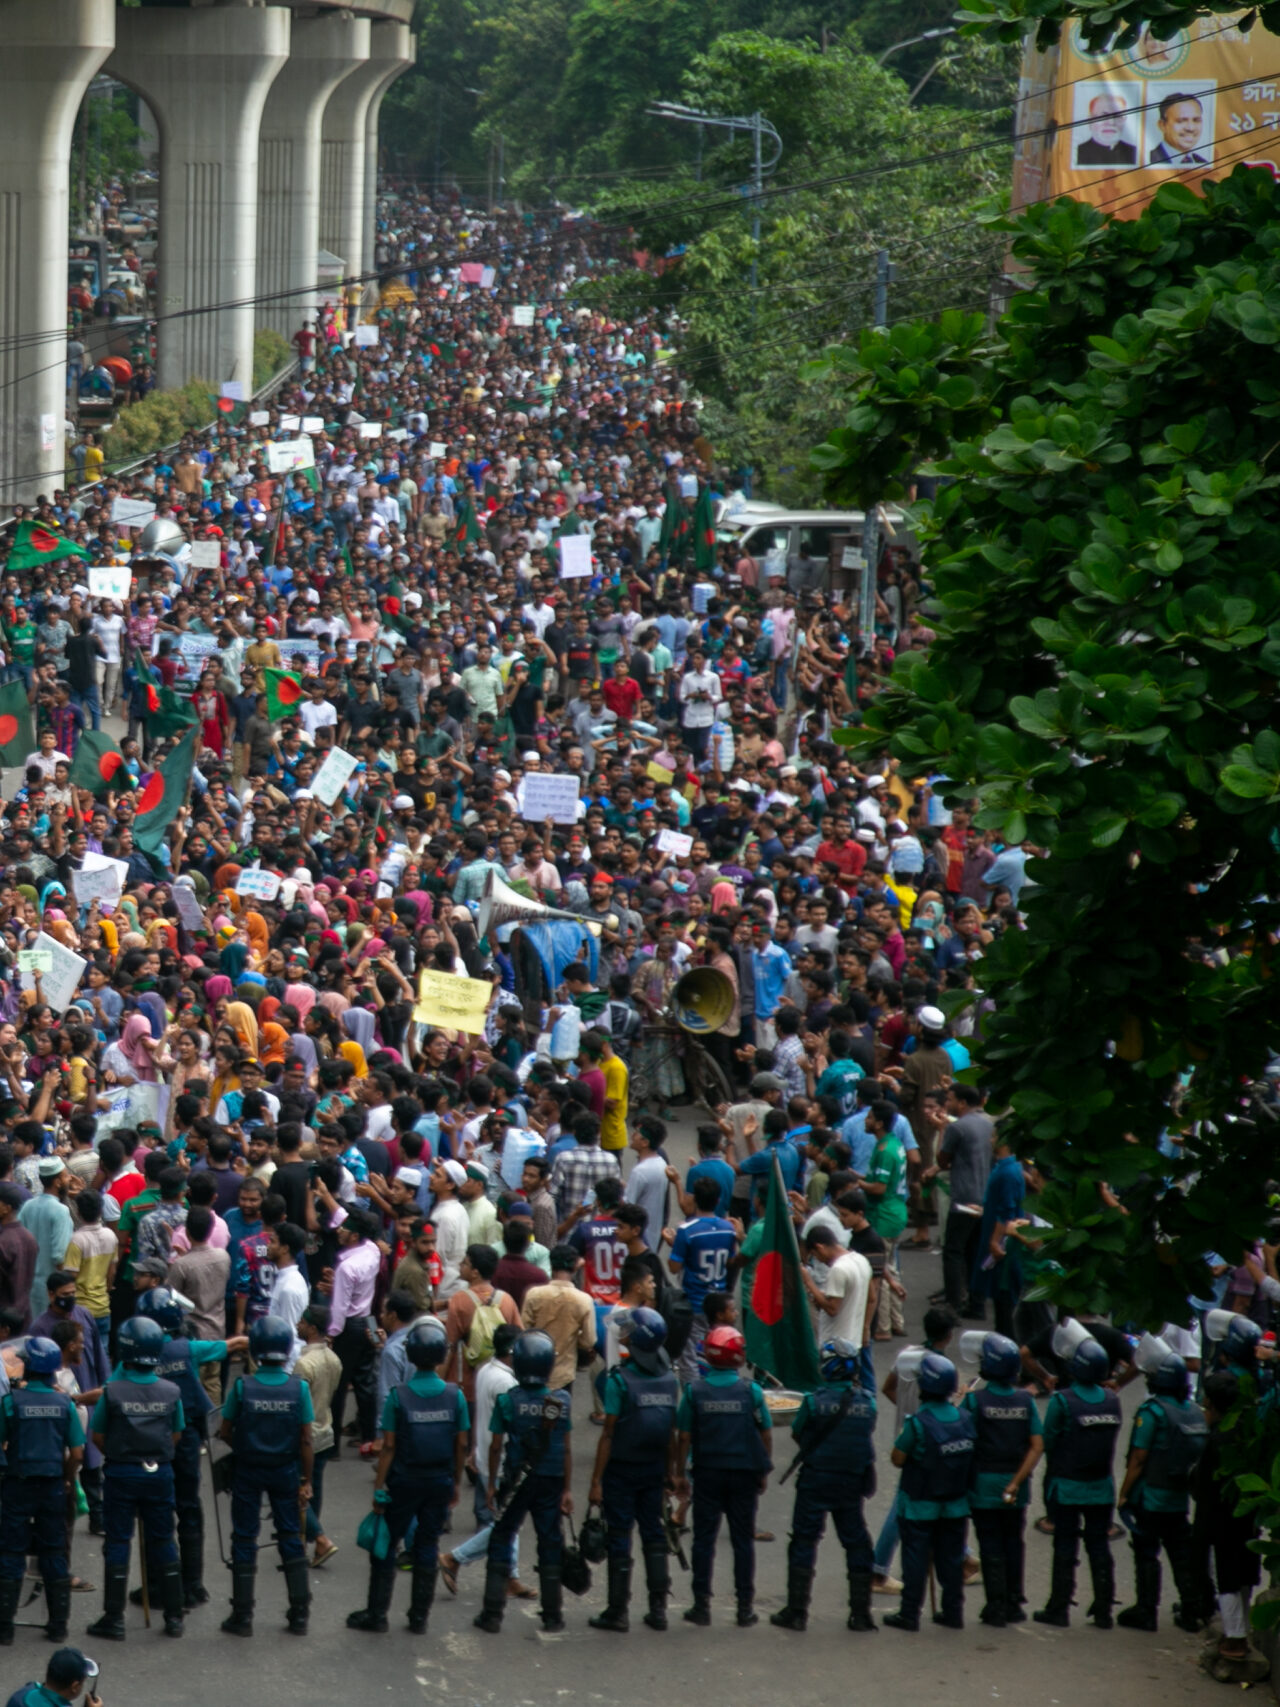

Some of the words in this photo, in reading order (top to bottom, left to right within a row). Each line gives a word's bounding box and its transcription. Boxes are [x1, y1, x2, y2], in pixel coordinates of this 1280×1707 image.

[1230, 111, 1256, 133] ২১
[698, 1248, 730, 1282] 50
[155, 1361, 186, 1375] OLICE
[27, 1407, 60, 1416] POLICE
[123, 1402, 167, 1413] POLICE
[254, 1401, 290, 1411] POLICE
[987, 1408, 1025, 1419] POLICE
